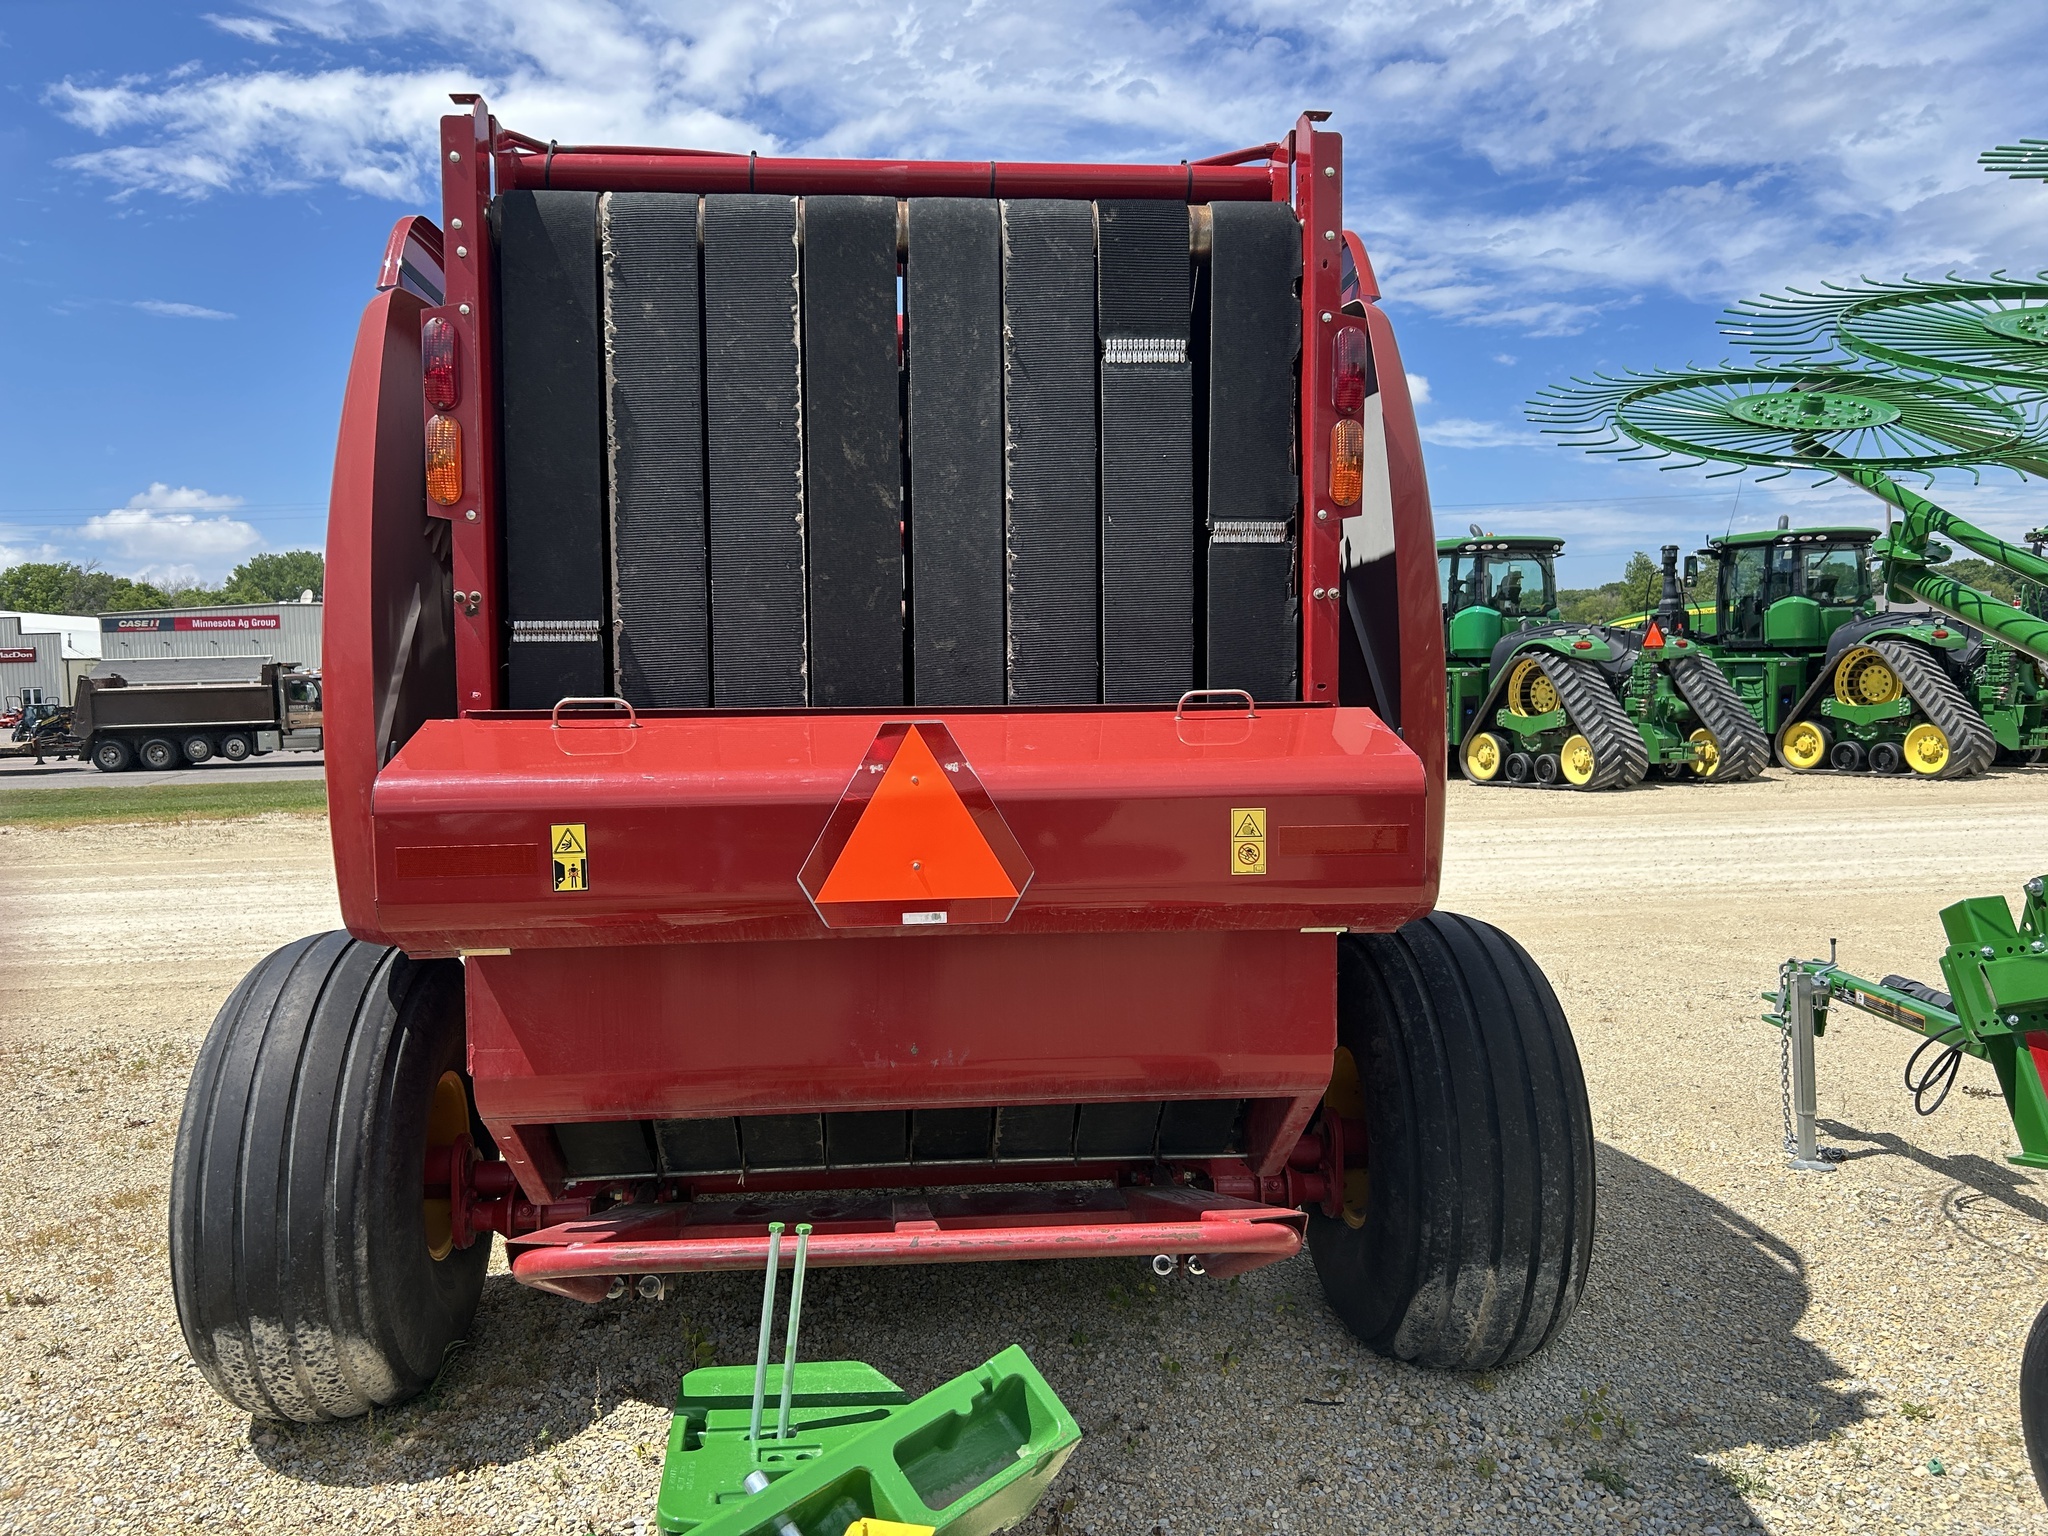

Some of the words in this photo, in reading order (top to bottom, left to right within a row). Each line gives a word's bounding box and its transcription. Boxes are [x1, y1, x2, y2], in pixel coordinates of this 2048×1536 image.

[192, 619, 236, 628] Minnesota
[238, 618, 249, 629] Ag
[251, 618, 277, 628] Group
